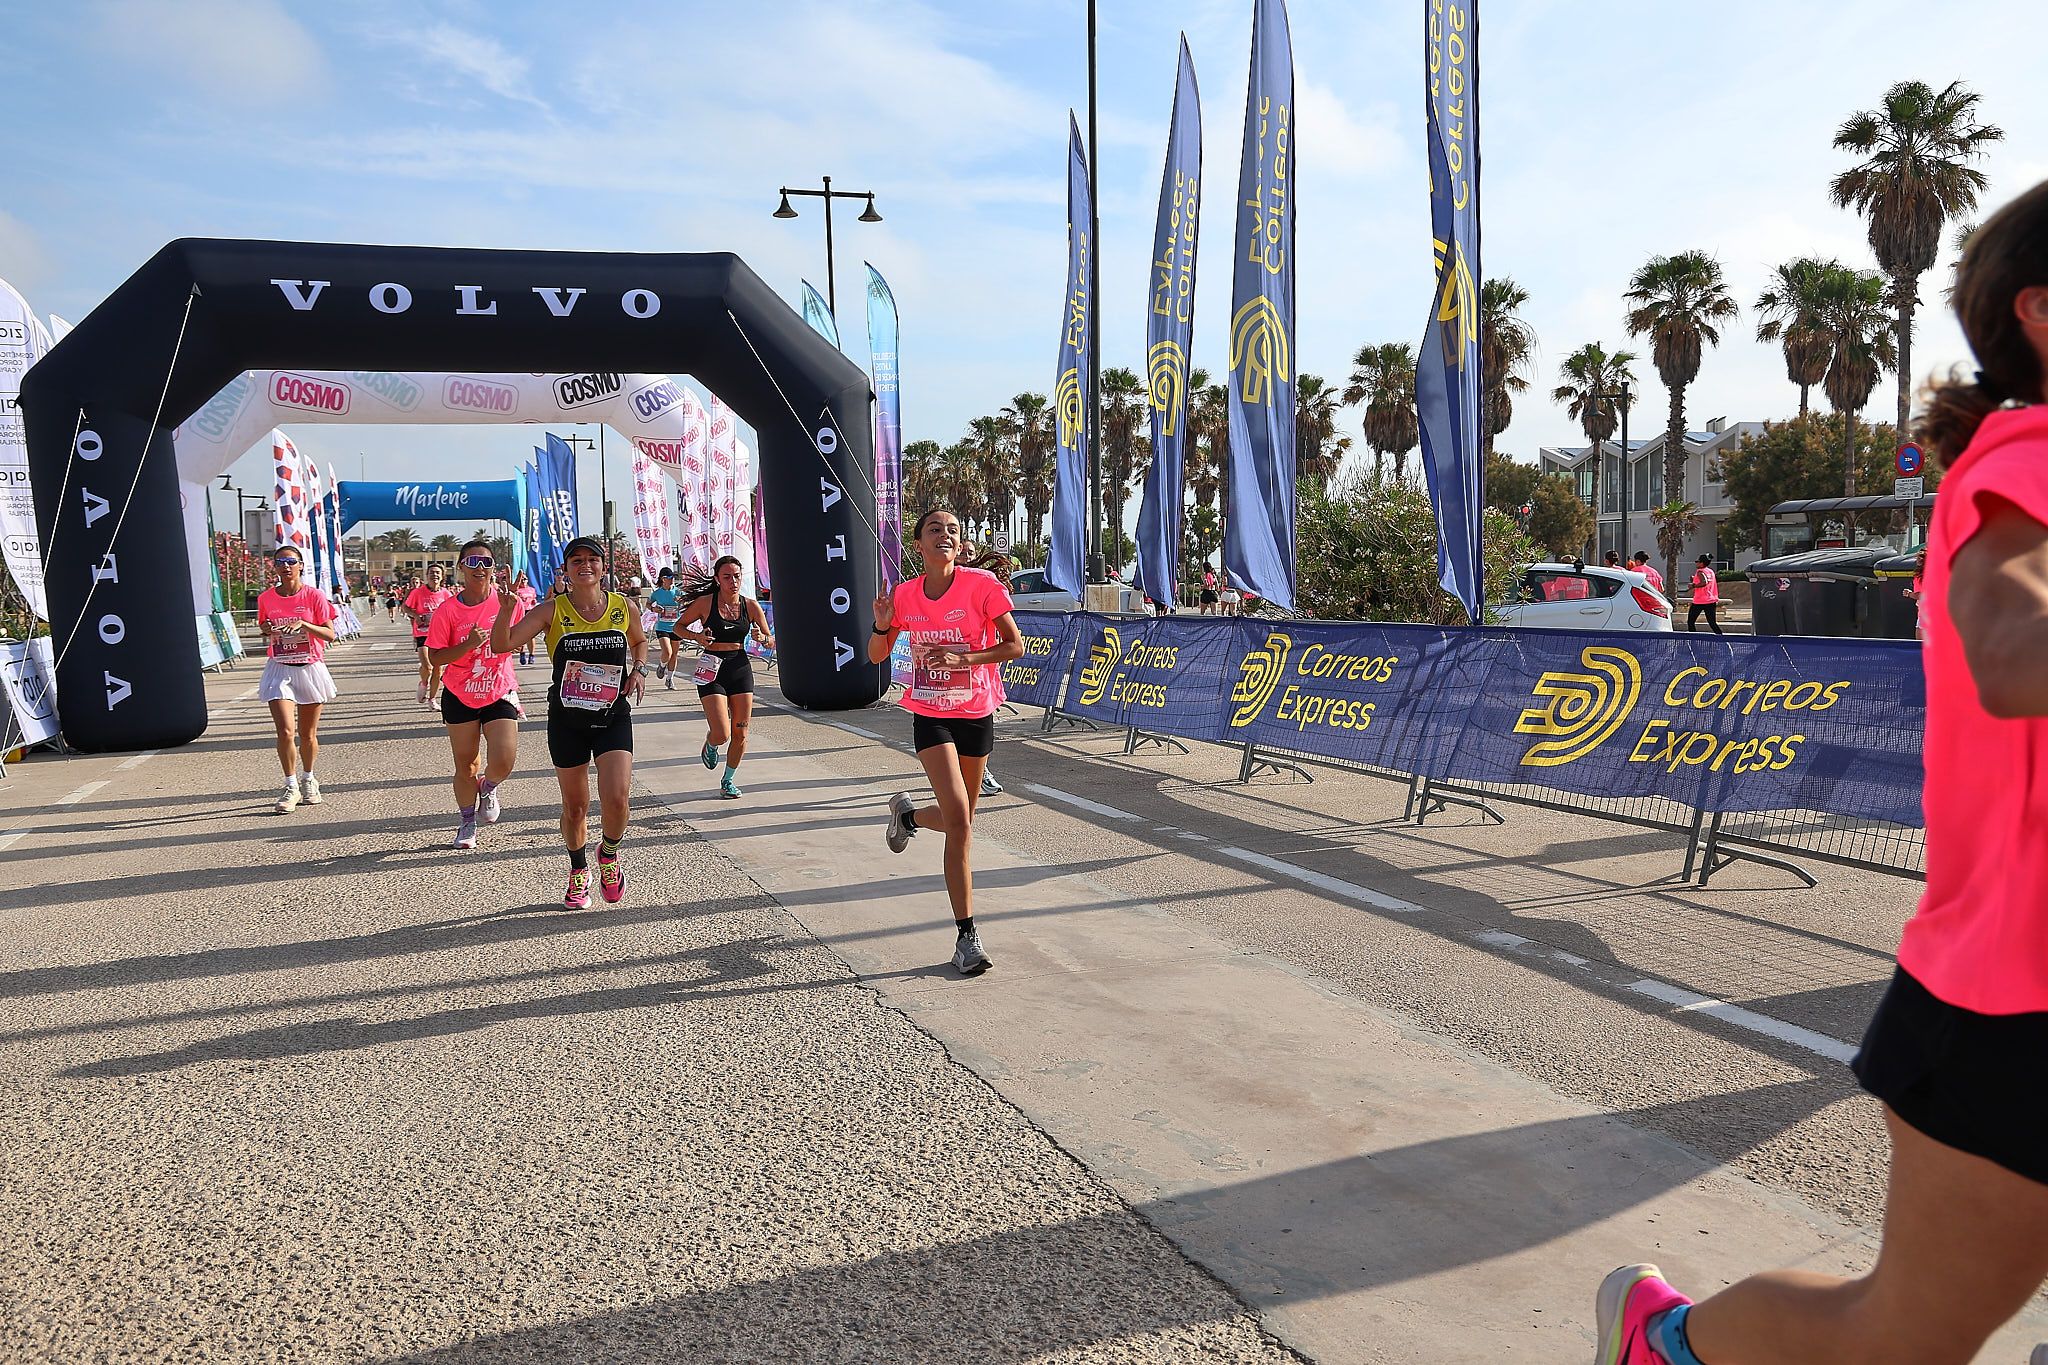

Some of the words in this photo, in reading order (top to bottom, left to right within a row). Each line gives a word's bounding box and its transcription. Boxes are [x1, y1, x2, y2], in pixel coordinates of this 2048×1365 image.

[270, 278, 662, 319] VOLVO
[276, 376, 344, 411] COSMO
[450, 380, 513, 411] COSMO
[560, 372, 621, 405] COSMO
[638, 440, 682, 465] COSM
[395, 484, 469, 516] Marlene
[816, 426, 855, 672] VOLVO
[76, 429, 133, 711] VOLVO
[564, 638, 594, 648] PATERNA
[595, 635, 624, 645] RUNNERS
[1123, 639, 1179, 670] Correos
[929, 670, 951, 681] 016
[1298, 643, 1401, 684] Correos
[580, 681, 602, 693] 016
[1110, 673, 1168, 709] Express
[1663, 666, 1852, 716] Correos
[1276, 684, 1377, 732] Express
[1628, 719, 1806, 775] Express
